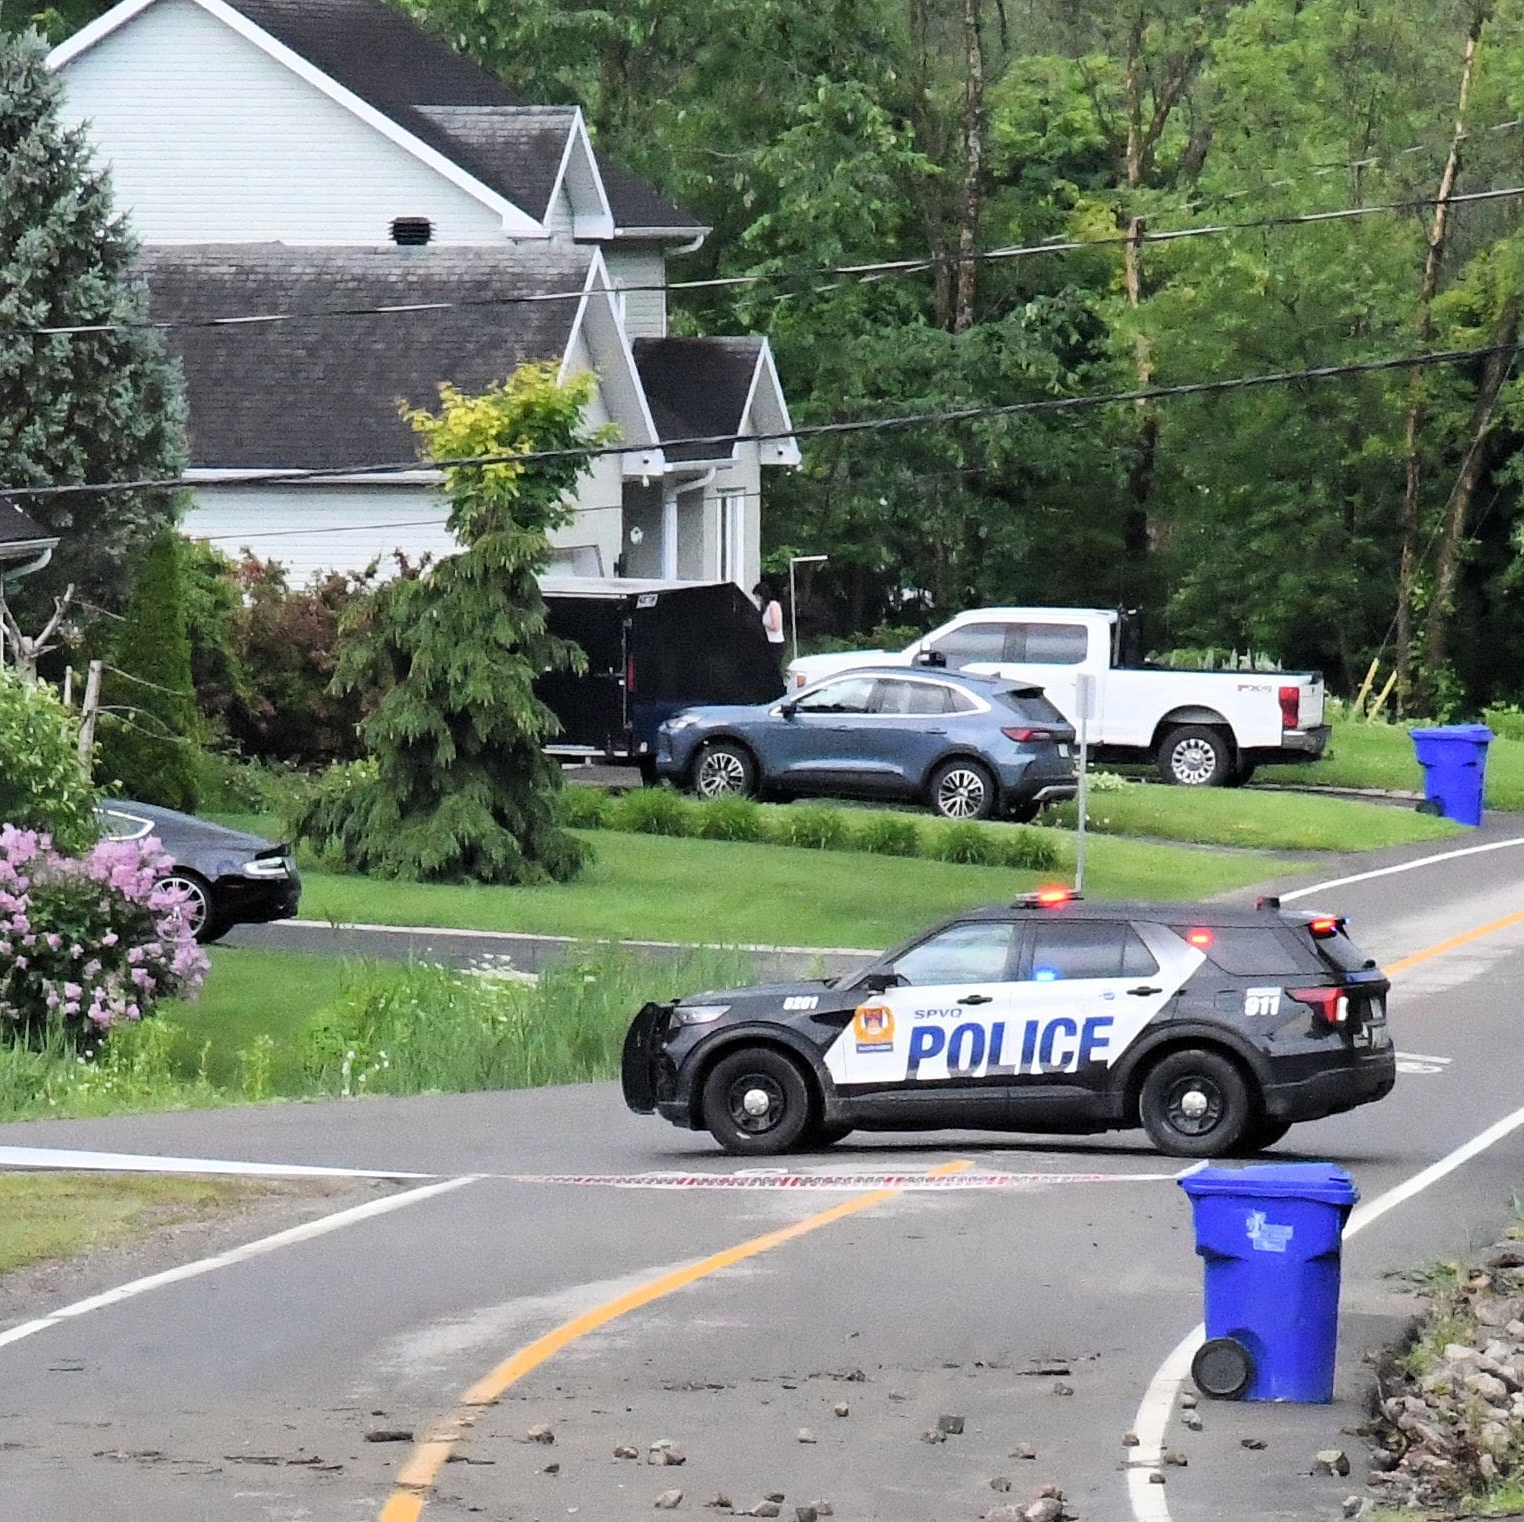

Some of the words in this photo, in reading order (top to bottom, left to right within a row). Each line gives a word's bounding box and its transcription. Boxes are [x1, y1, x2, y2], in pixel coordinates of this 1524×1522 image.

[914, 1008, 962, 1020] SPVQ
[1245, 996, 1280, 1016] 911
[905, 1016, 1114, 1081] POLICE
